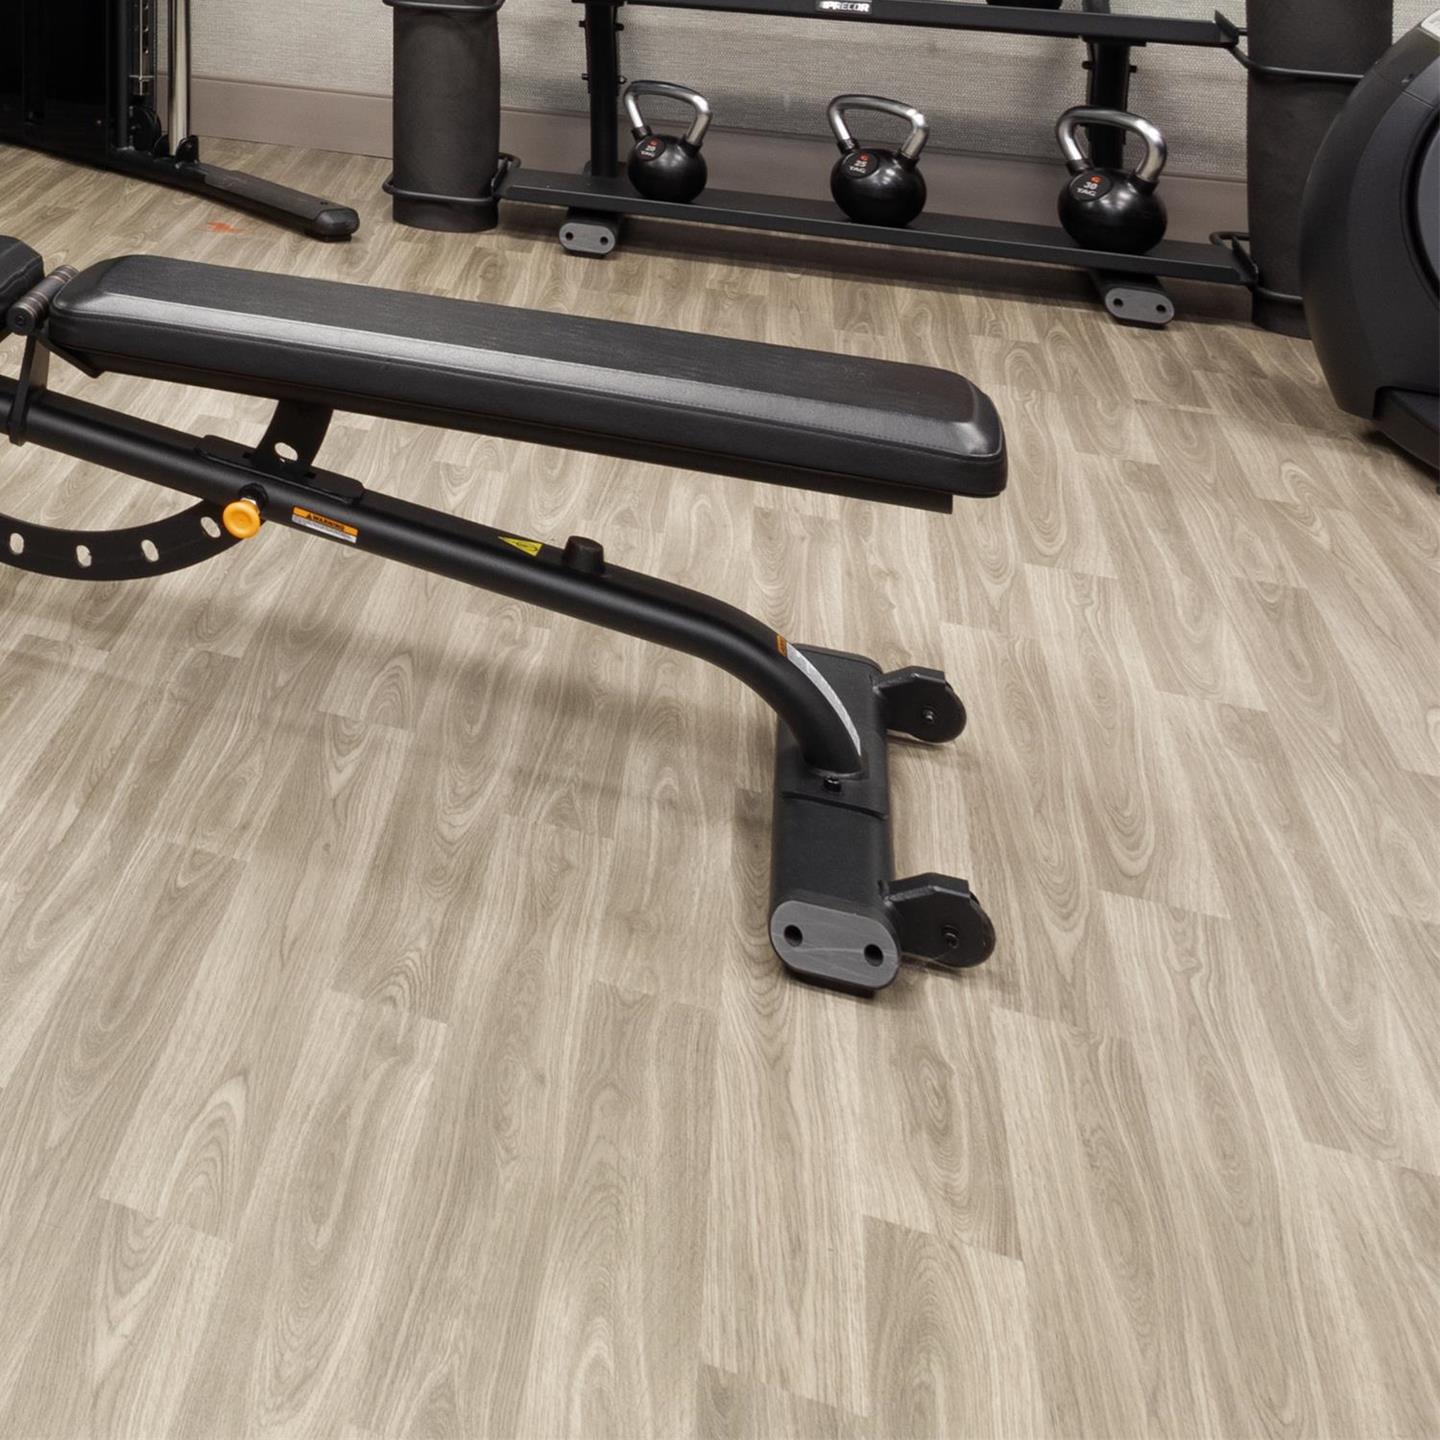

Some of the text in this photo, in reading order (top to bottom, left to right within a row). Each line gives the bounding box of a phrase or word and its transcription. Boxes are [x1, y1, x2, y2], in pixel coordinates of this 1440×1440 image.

[823, 0, 870, 13] PRECOR
[1083, 181, 1098, 190] 30
[1077, 188, 1097, 197] TAG
